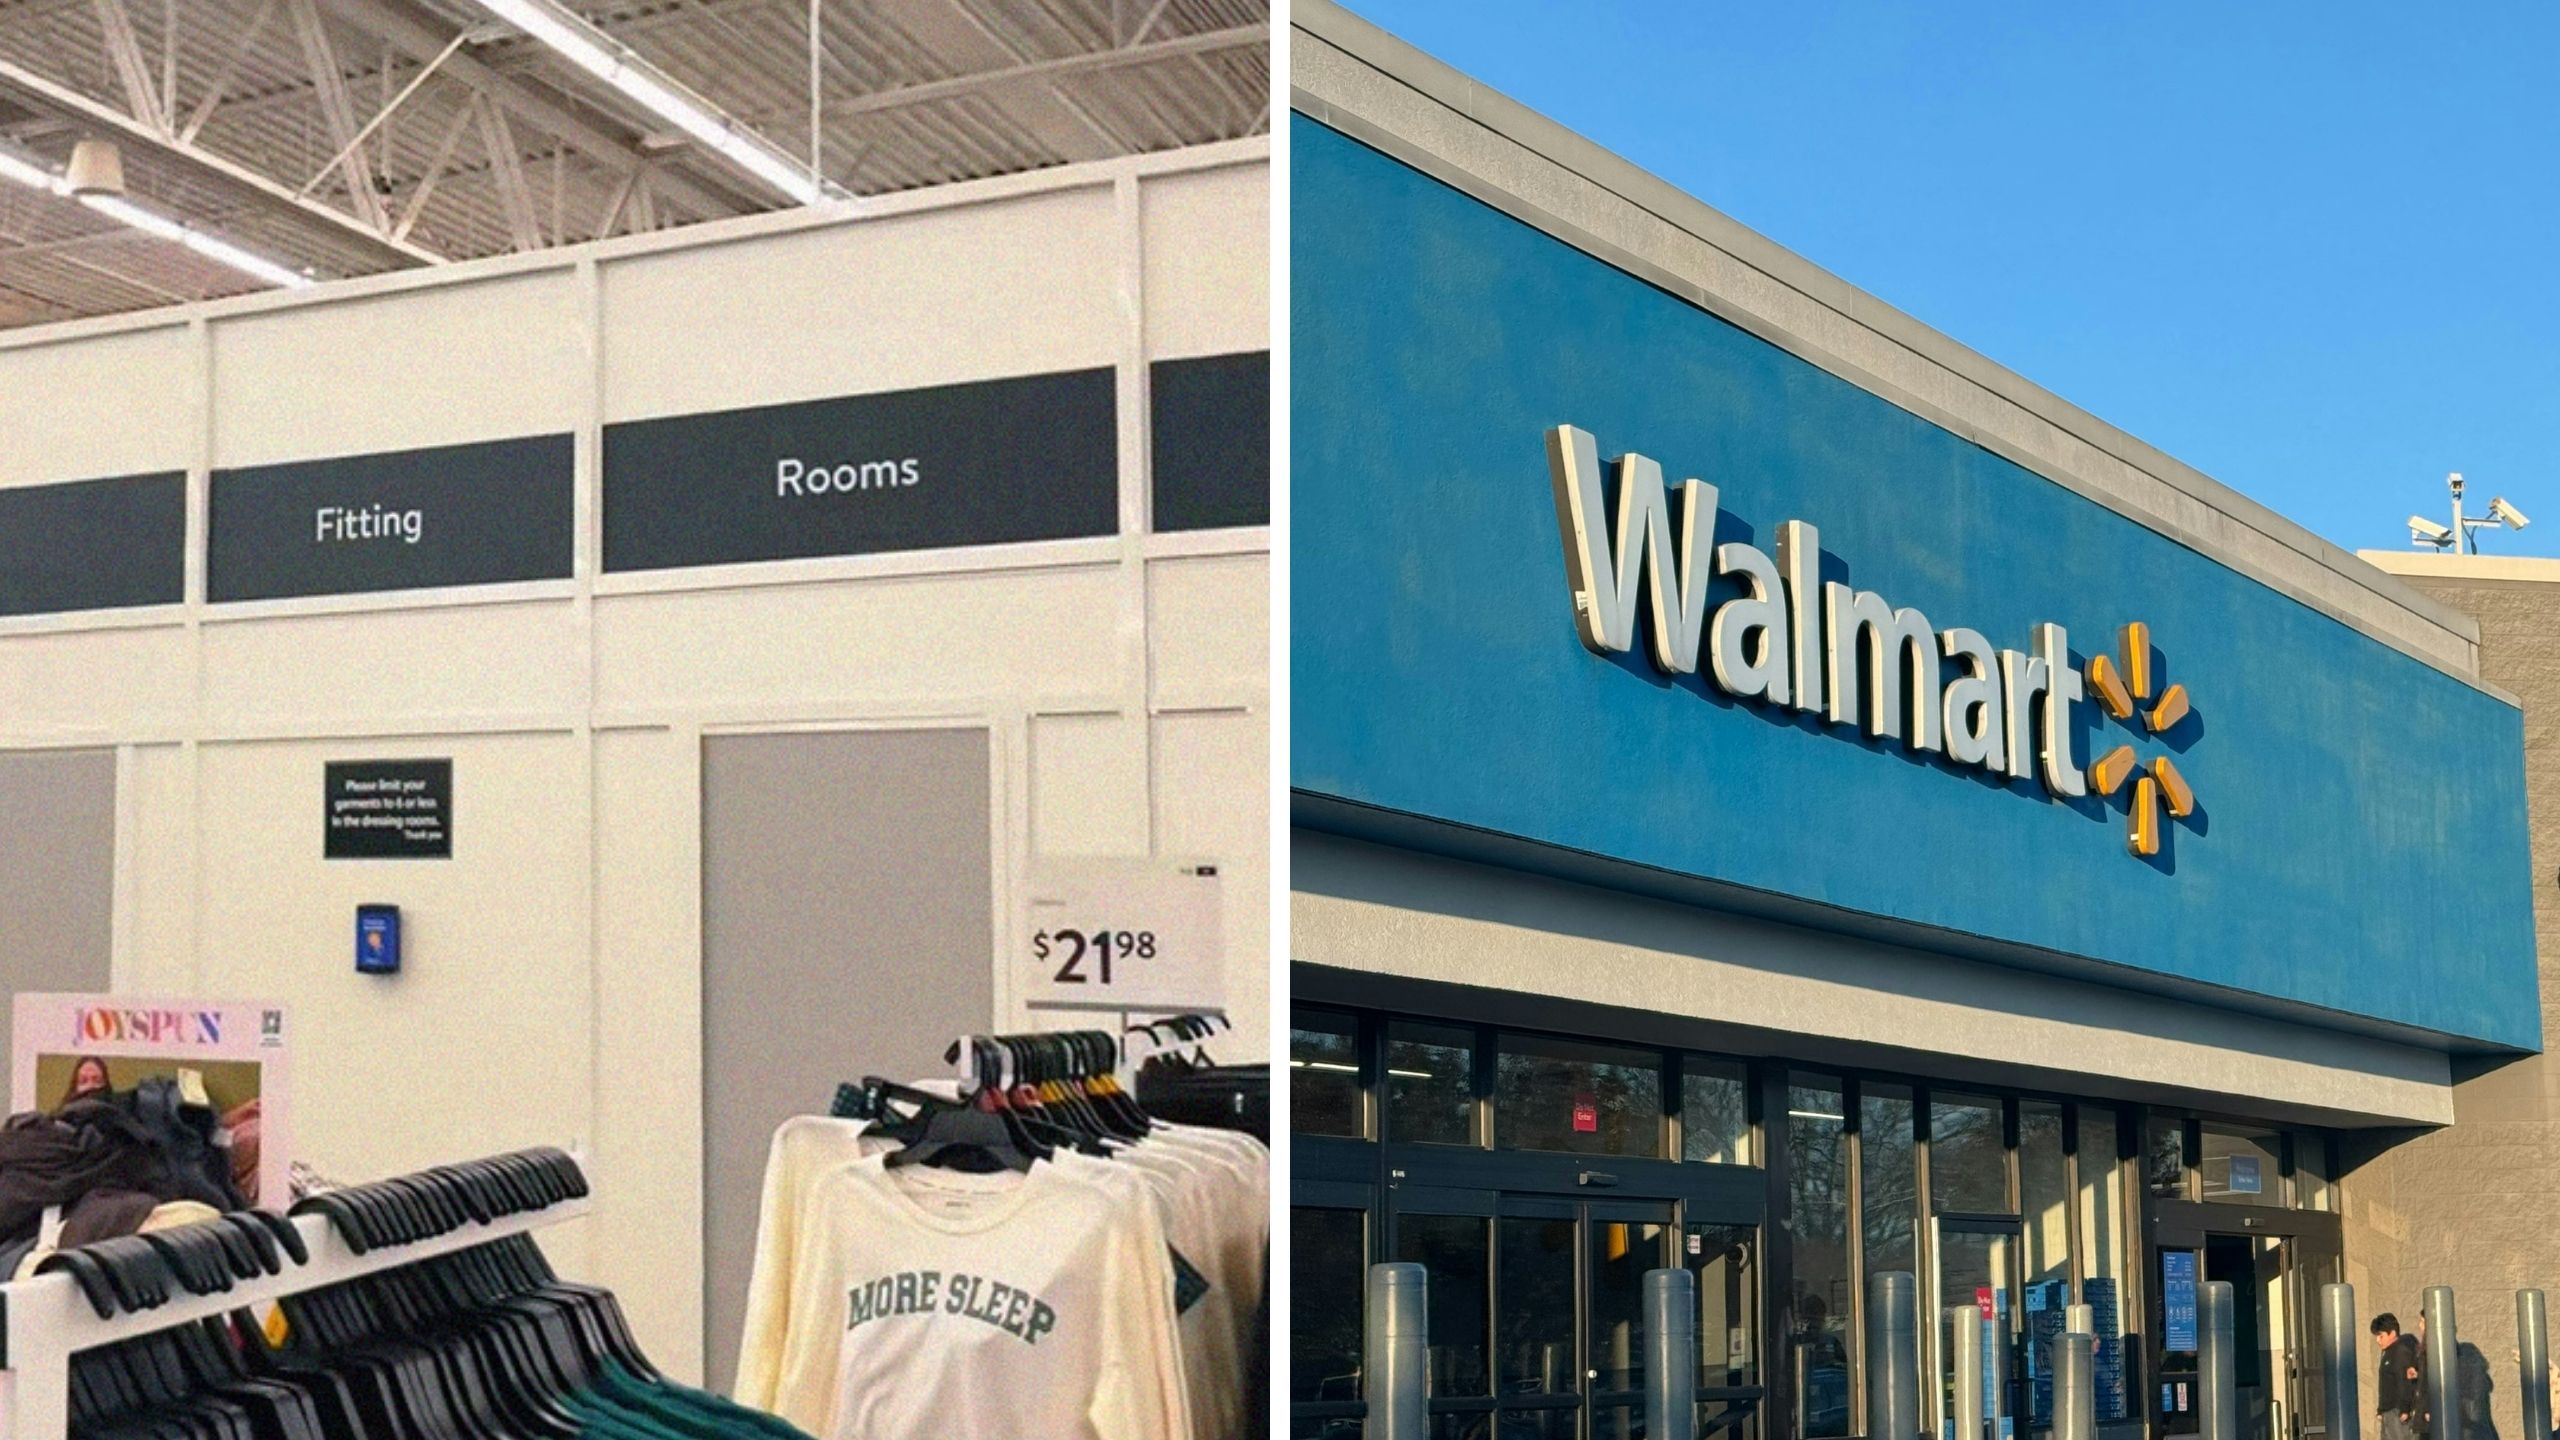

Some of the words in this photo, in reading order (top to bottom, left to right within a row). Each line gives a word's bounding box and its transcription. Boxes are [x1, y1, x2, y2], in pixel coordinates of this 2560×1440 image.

[317, 503, 423, 544] Fitting
[777, 458, 920, 497] Rooms
[1546, 424, 2086, 797] Walmart
[345, 779, 377, 792] Please
[379, 779, 401, 791] limit
[402, 780, 426, 794] your
[334, 798, 381, 813] garments
[383, 797, 394, 809] to
[405, 799, 416, 809] or
[417, 796, 437, 809] less
[343, 814, 360, 827] the
[362, 814, 404, 830] dressing
[404, 829, 426, 839] Thank
[428, 830, 443, 841] you
[72, 1007, 222, 1046] JOYSPUN
[848, 1271, 941, 1330] MORE
[946, 1273, 1056, 1345] SLEEP
